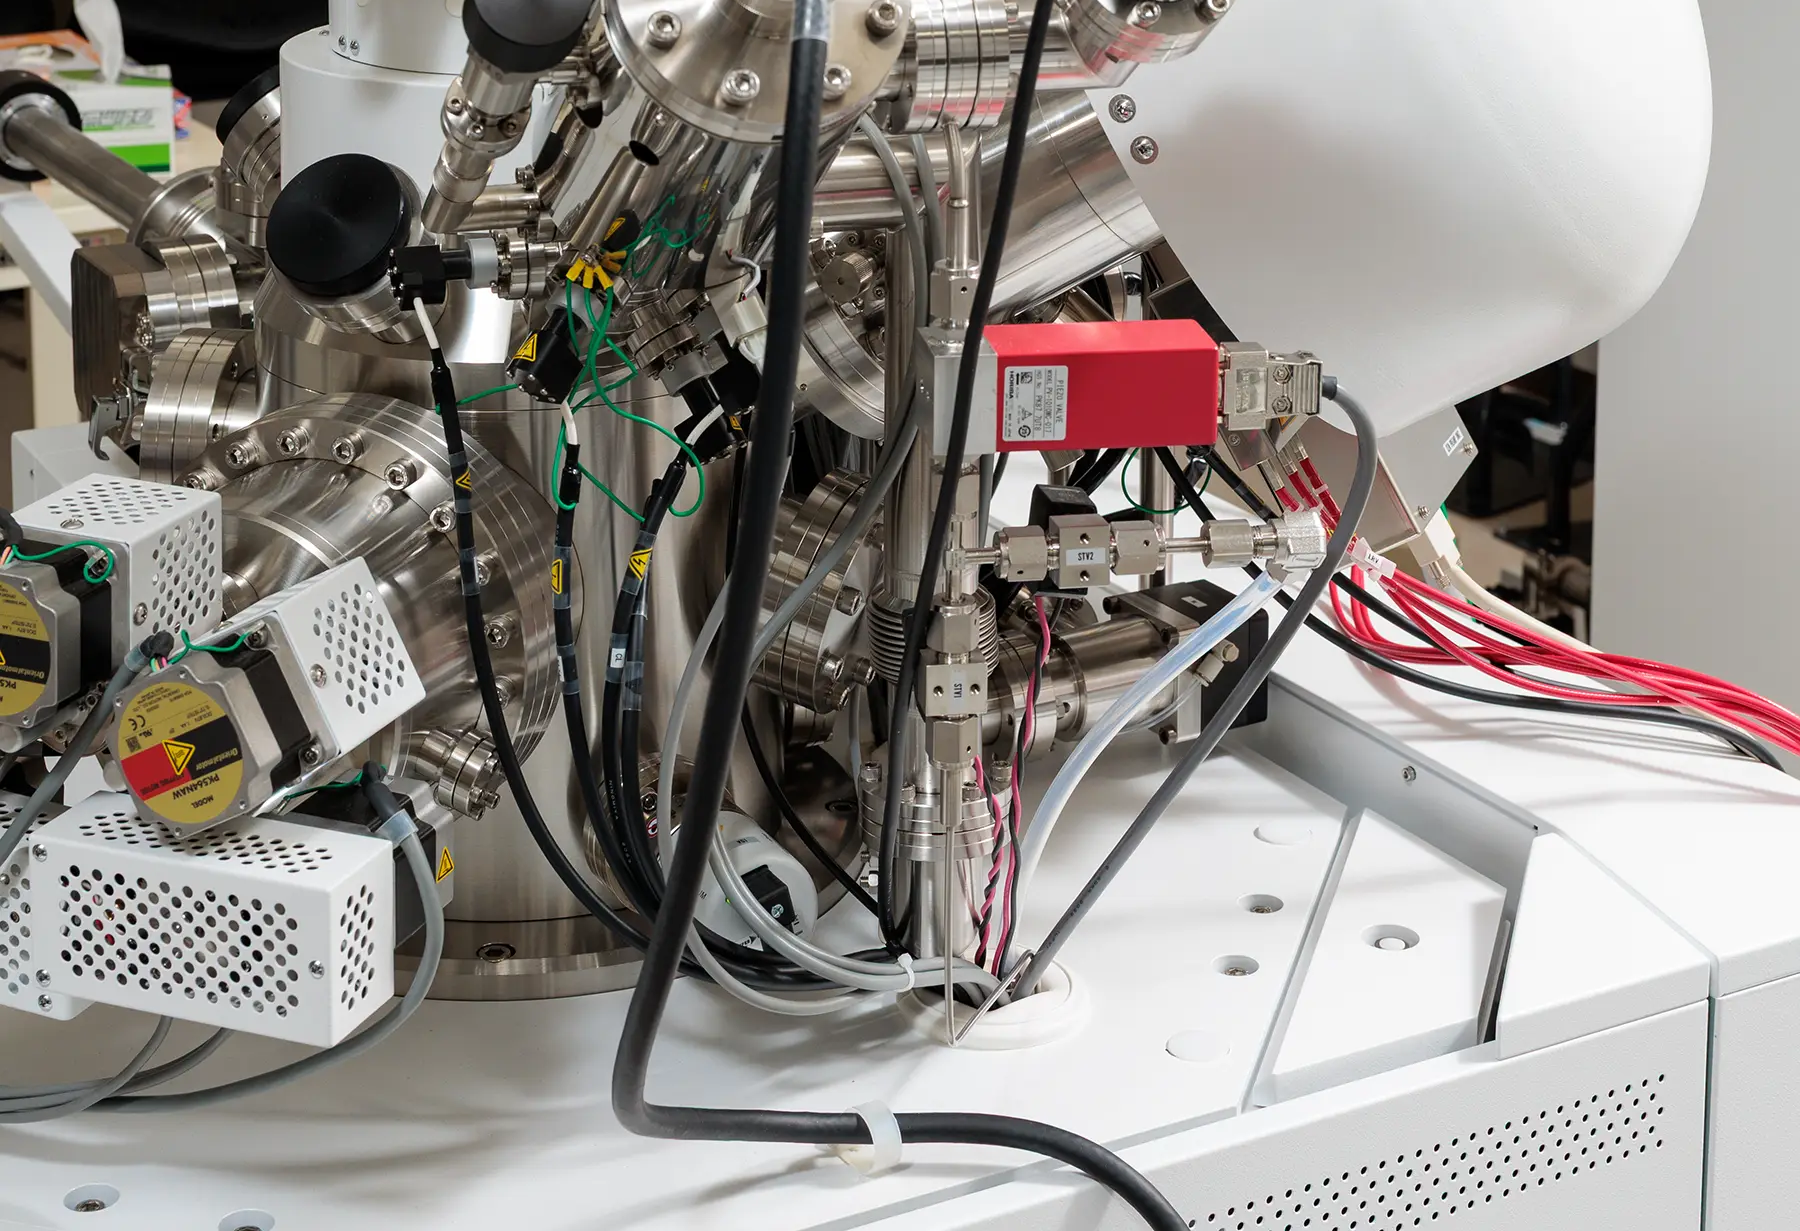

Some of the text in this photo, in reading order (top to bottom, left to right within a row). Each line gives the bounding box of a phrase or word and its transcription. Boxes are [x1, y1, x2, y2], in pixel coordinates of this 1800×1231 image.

[1056, 380, 1065, 424] PIEZO VALVE
[1077, 552, 1094, 561] STV2
[0, 665, 45, 679] Orientalmoto
[953, 683, 963, 699] STV1
[172, 773, 220, 801] PK564NAW
[190, 794, 214, 809] MODEL
